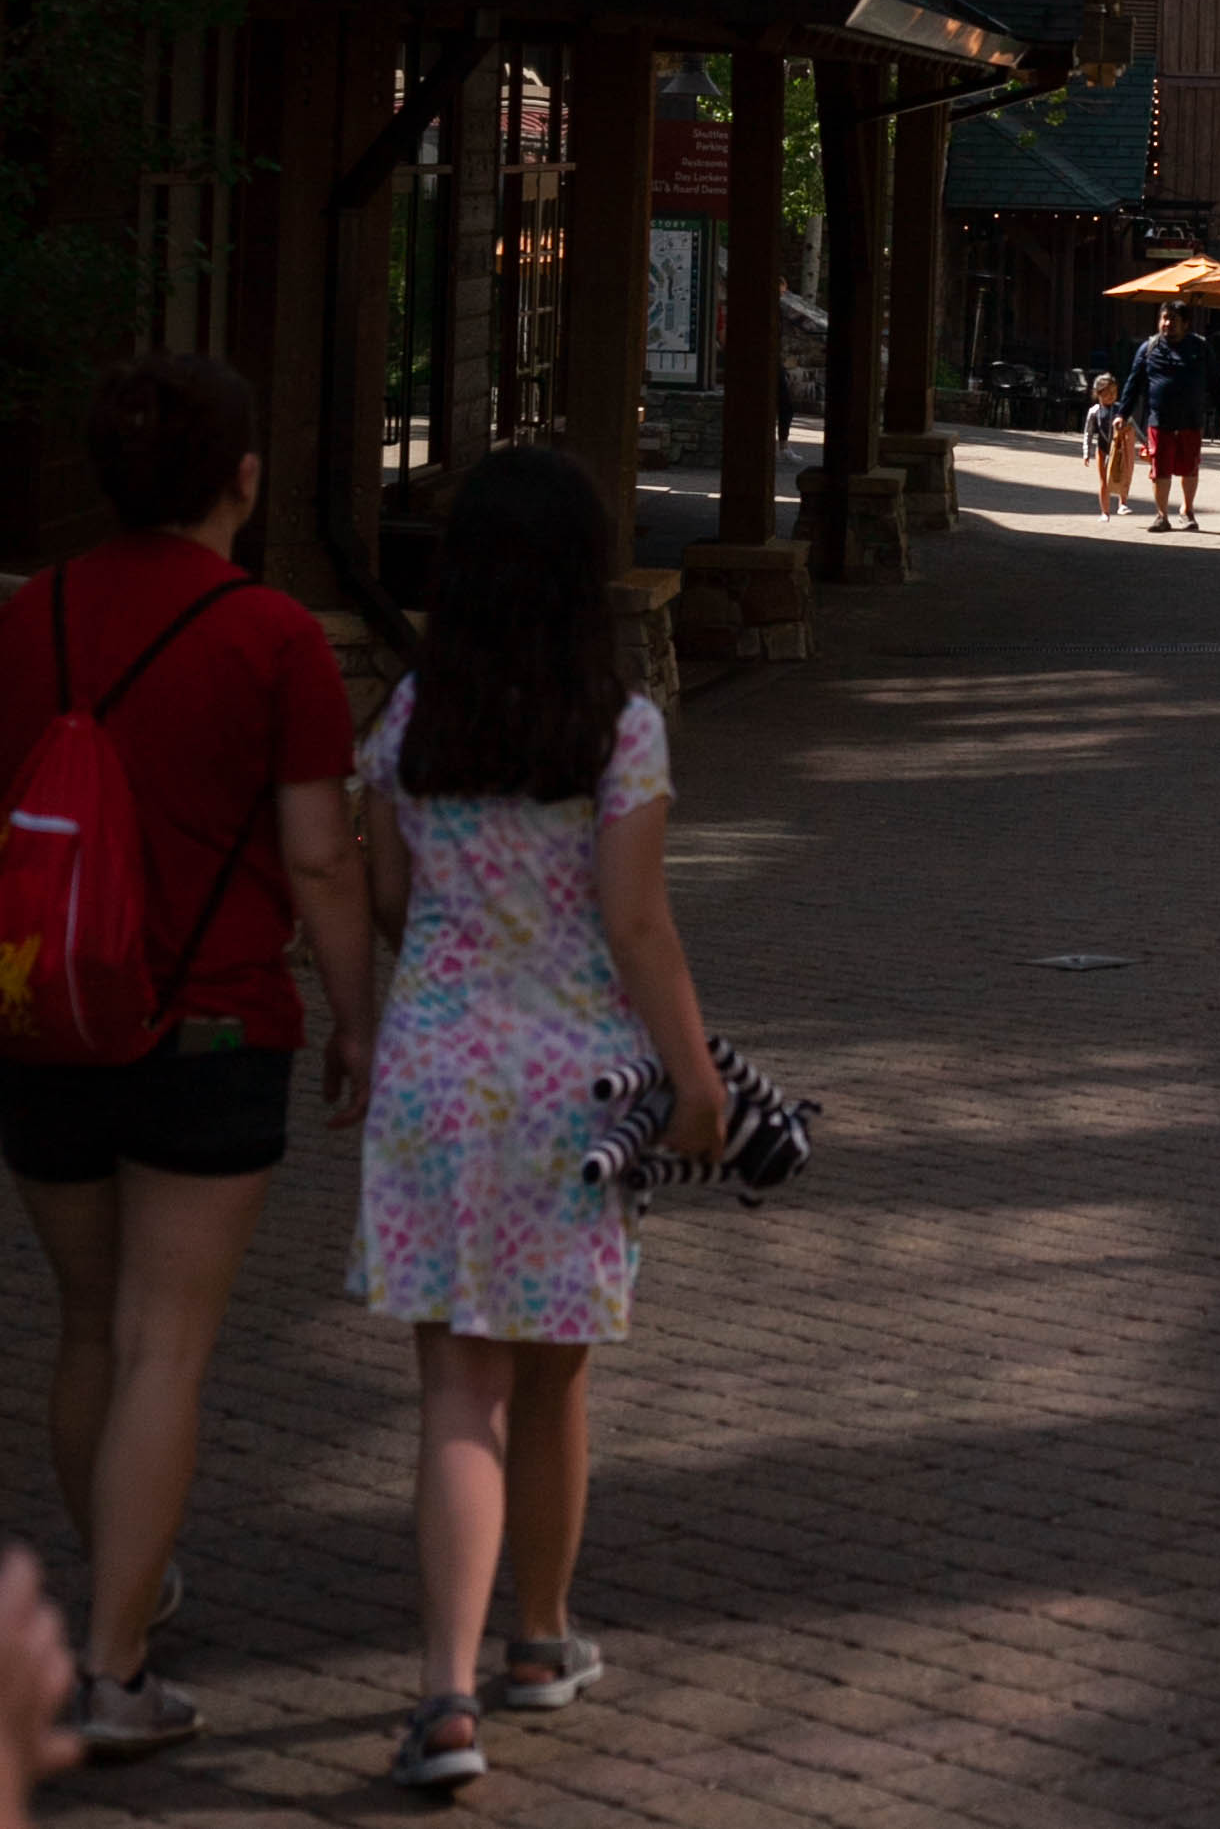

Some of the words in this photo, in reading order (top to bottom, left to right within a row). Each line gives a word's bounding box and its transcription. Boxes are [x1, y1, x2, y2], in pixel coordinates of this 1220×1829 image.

[692, 128, 728, 139] Shuttles
[696, 141, 728, 155] Parking
[674, 171, 691, 183] Day
[693, 171, 728, 183] Lockers
[701, 184, 728, 195] Demo
